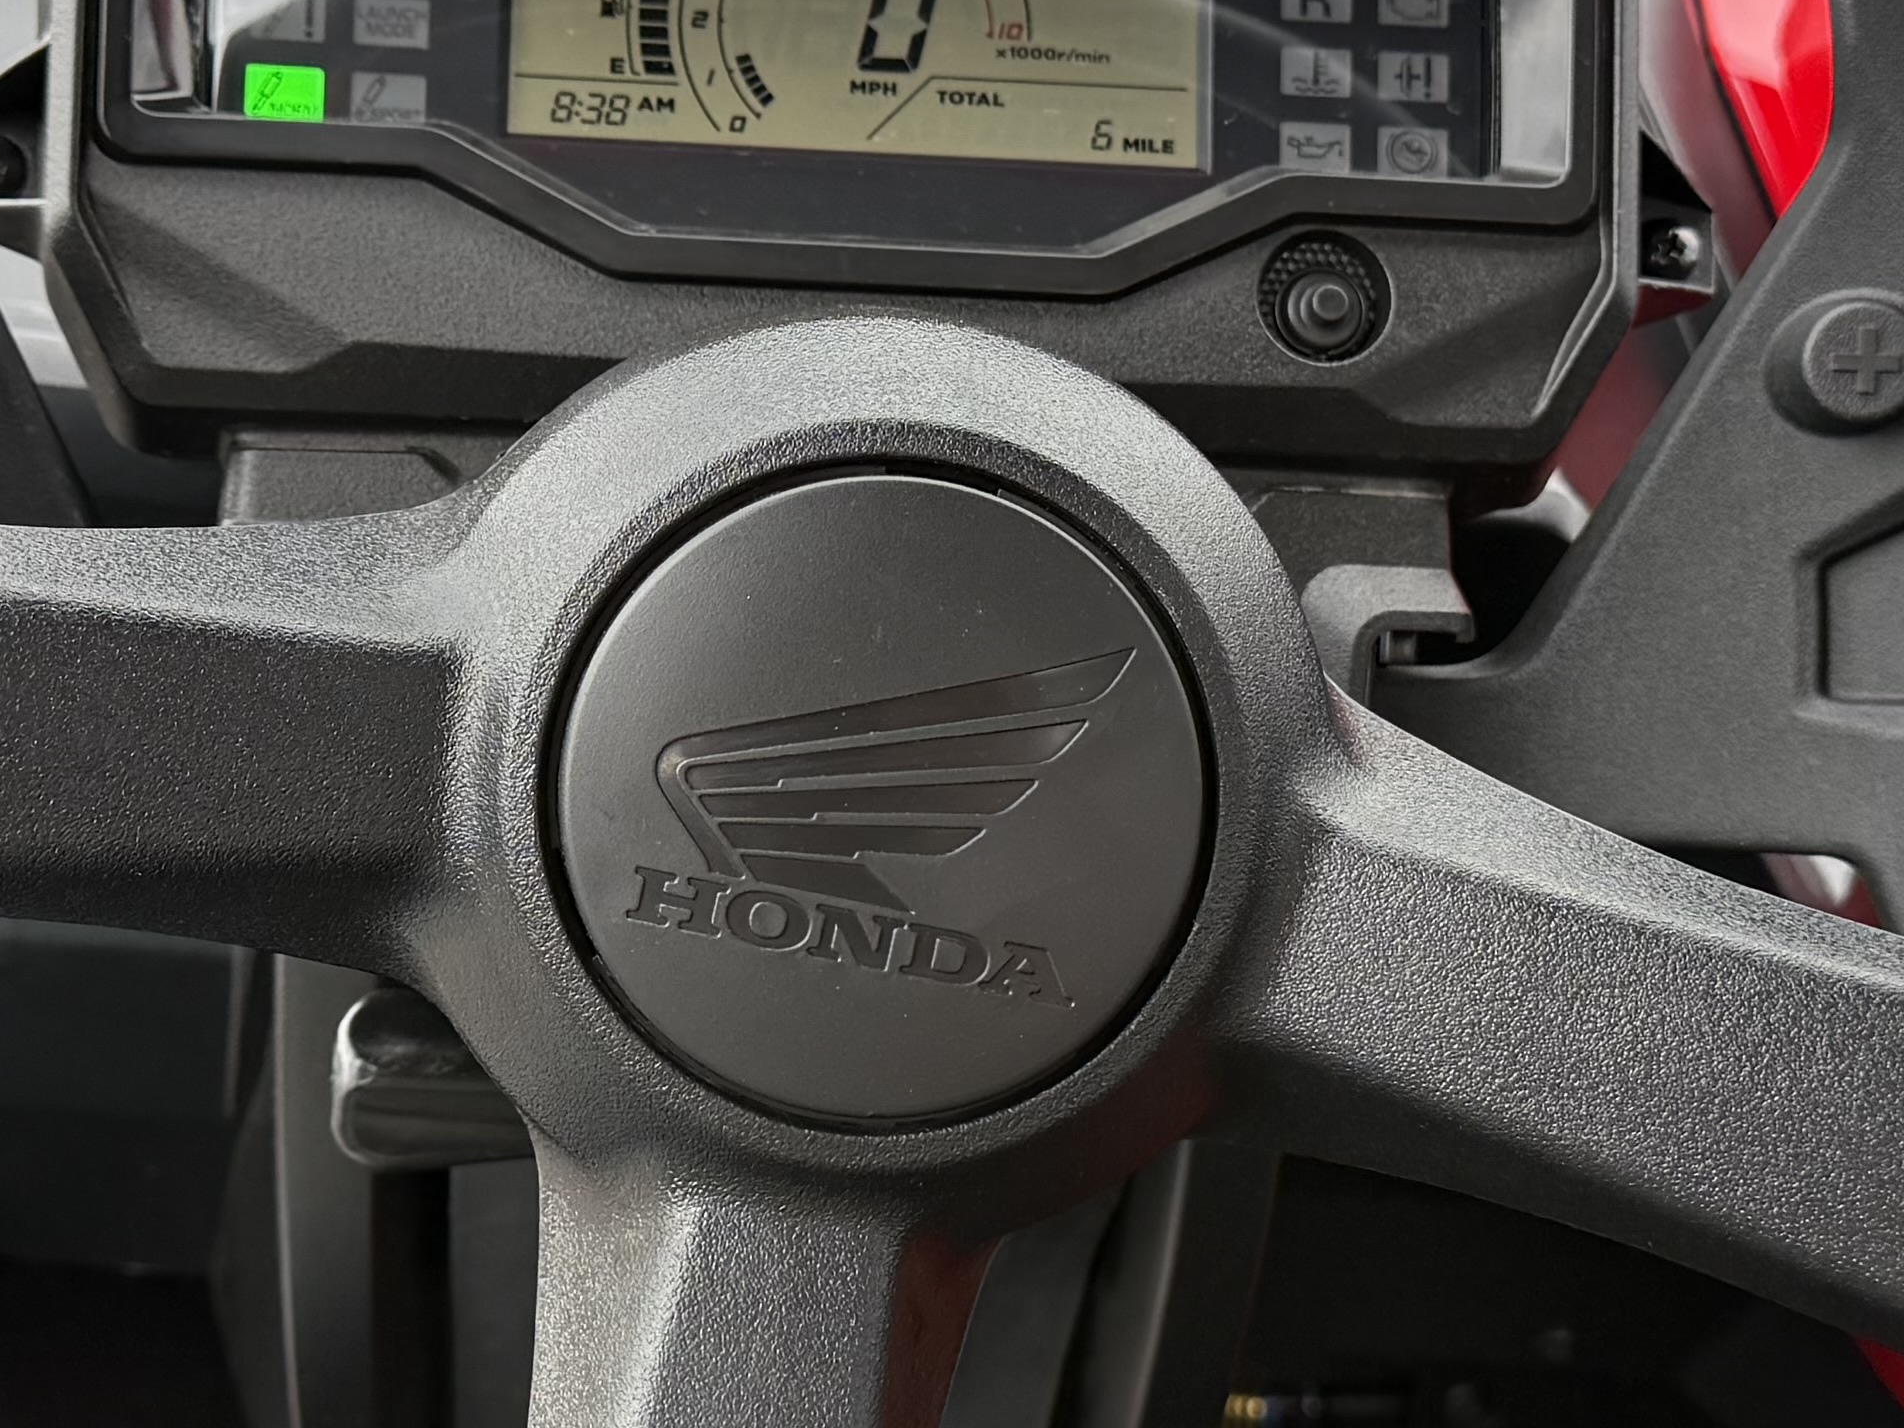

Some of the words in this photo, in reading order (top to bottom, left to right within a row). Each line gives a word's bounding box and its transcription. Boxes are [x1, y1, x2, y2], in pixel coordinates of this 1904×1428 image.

[691, 10, 709, 29] 2
[998, 22, 1024, 41] 10
[610, 57, 626, 74] E
[849, 79, 898, 97] MPH
[550, 90, 631, 126] 8:38
[637, 97, 676, 114] AM
[936, 90, 1006, 108] TOTAL
[1091, 119, 1113, 151] 6
[1123, 137, 1174, 155] MILE
[625, 864, 1076, 1009] HONDA
